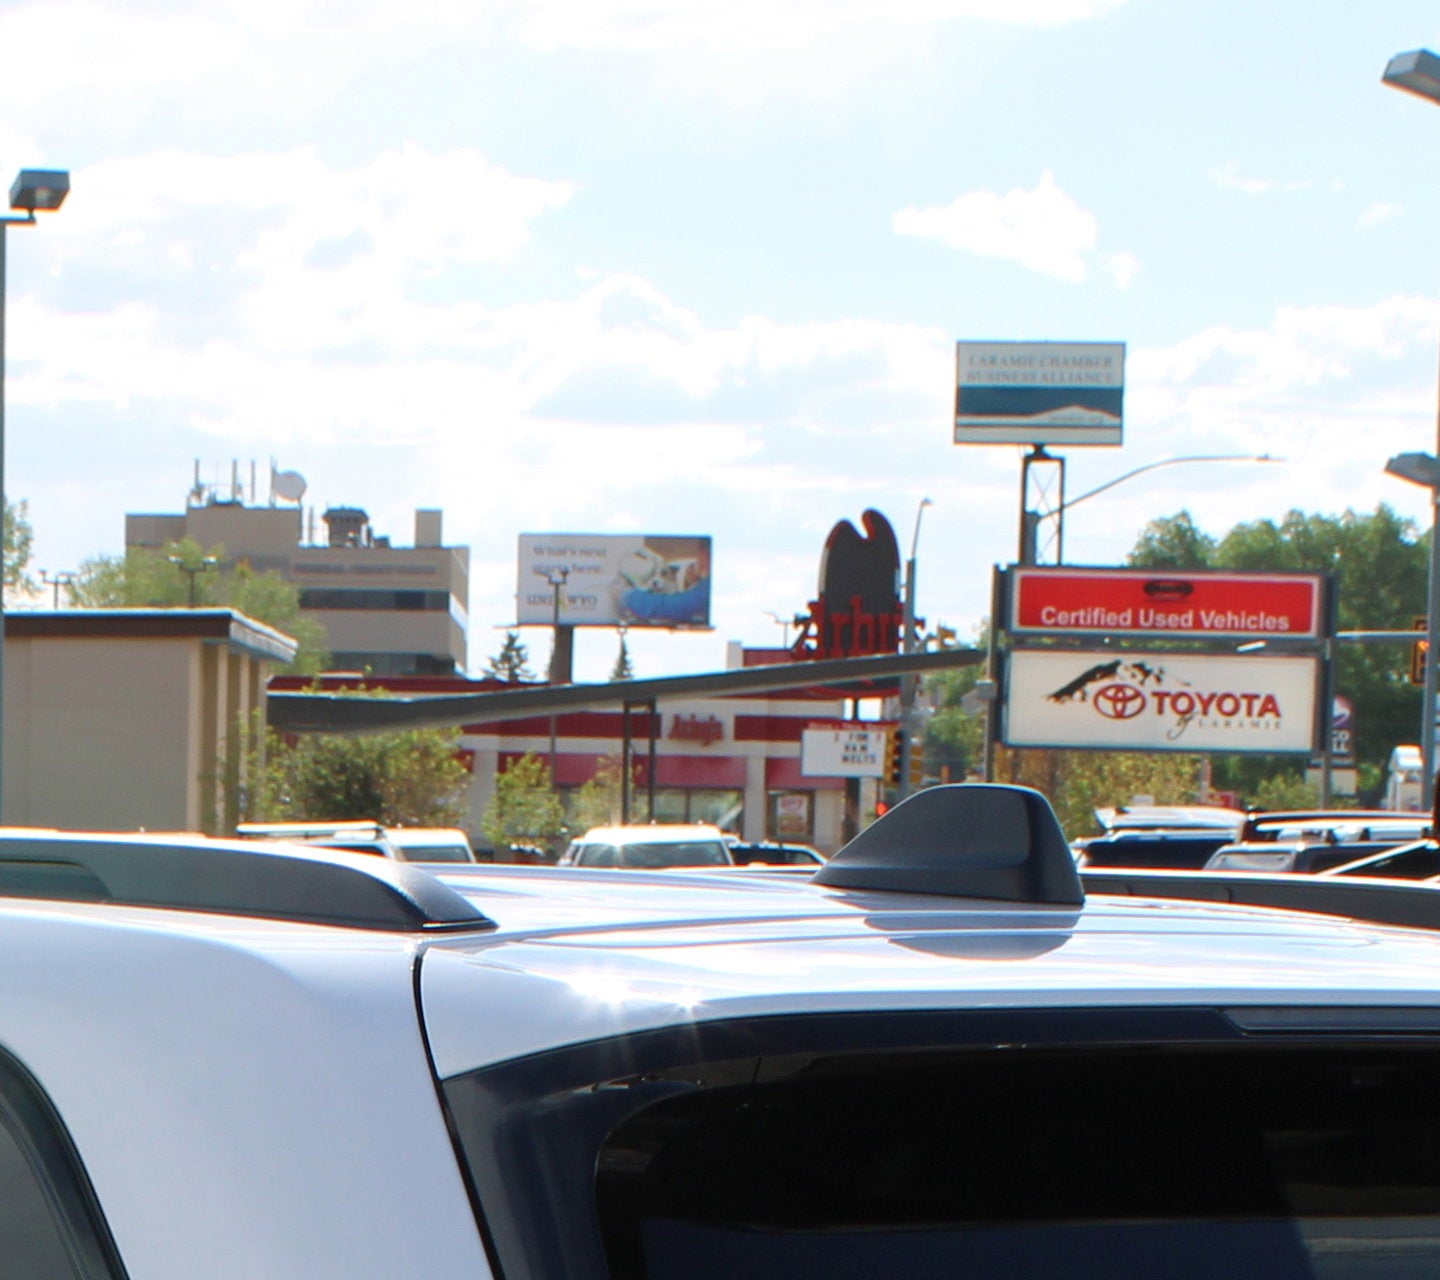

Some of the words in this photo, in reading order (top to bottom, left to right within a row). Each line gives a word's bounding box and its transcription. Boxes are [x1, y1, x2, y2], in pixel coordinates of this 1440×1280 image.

[969, 354, 1034, 368] LARAMIE
[1039, 355, 1113, 368] CHAMBER
[1040, 605, 1133, 628] Certified
[1138, 607, 1194, 629] Used
[1199, 609, 1290, 631] Vehicles
[1151, 690, 1282, 718] TOYOTA
[1198, 718, 1281, 730] LARAMIE
